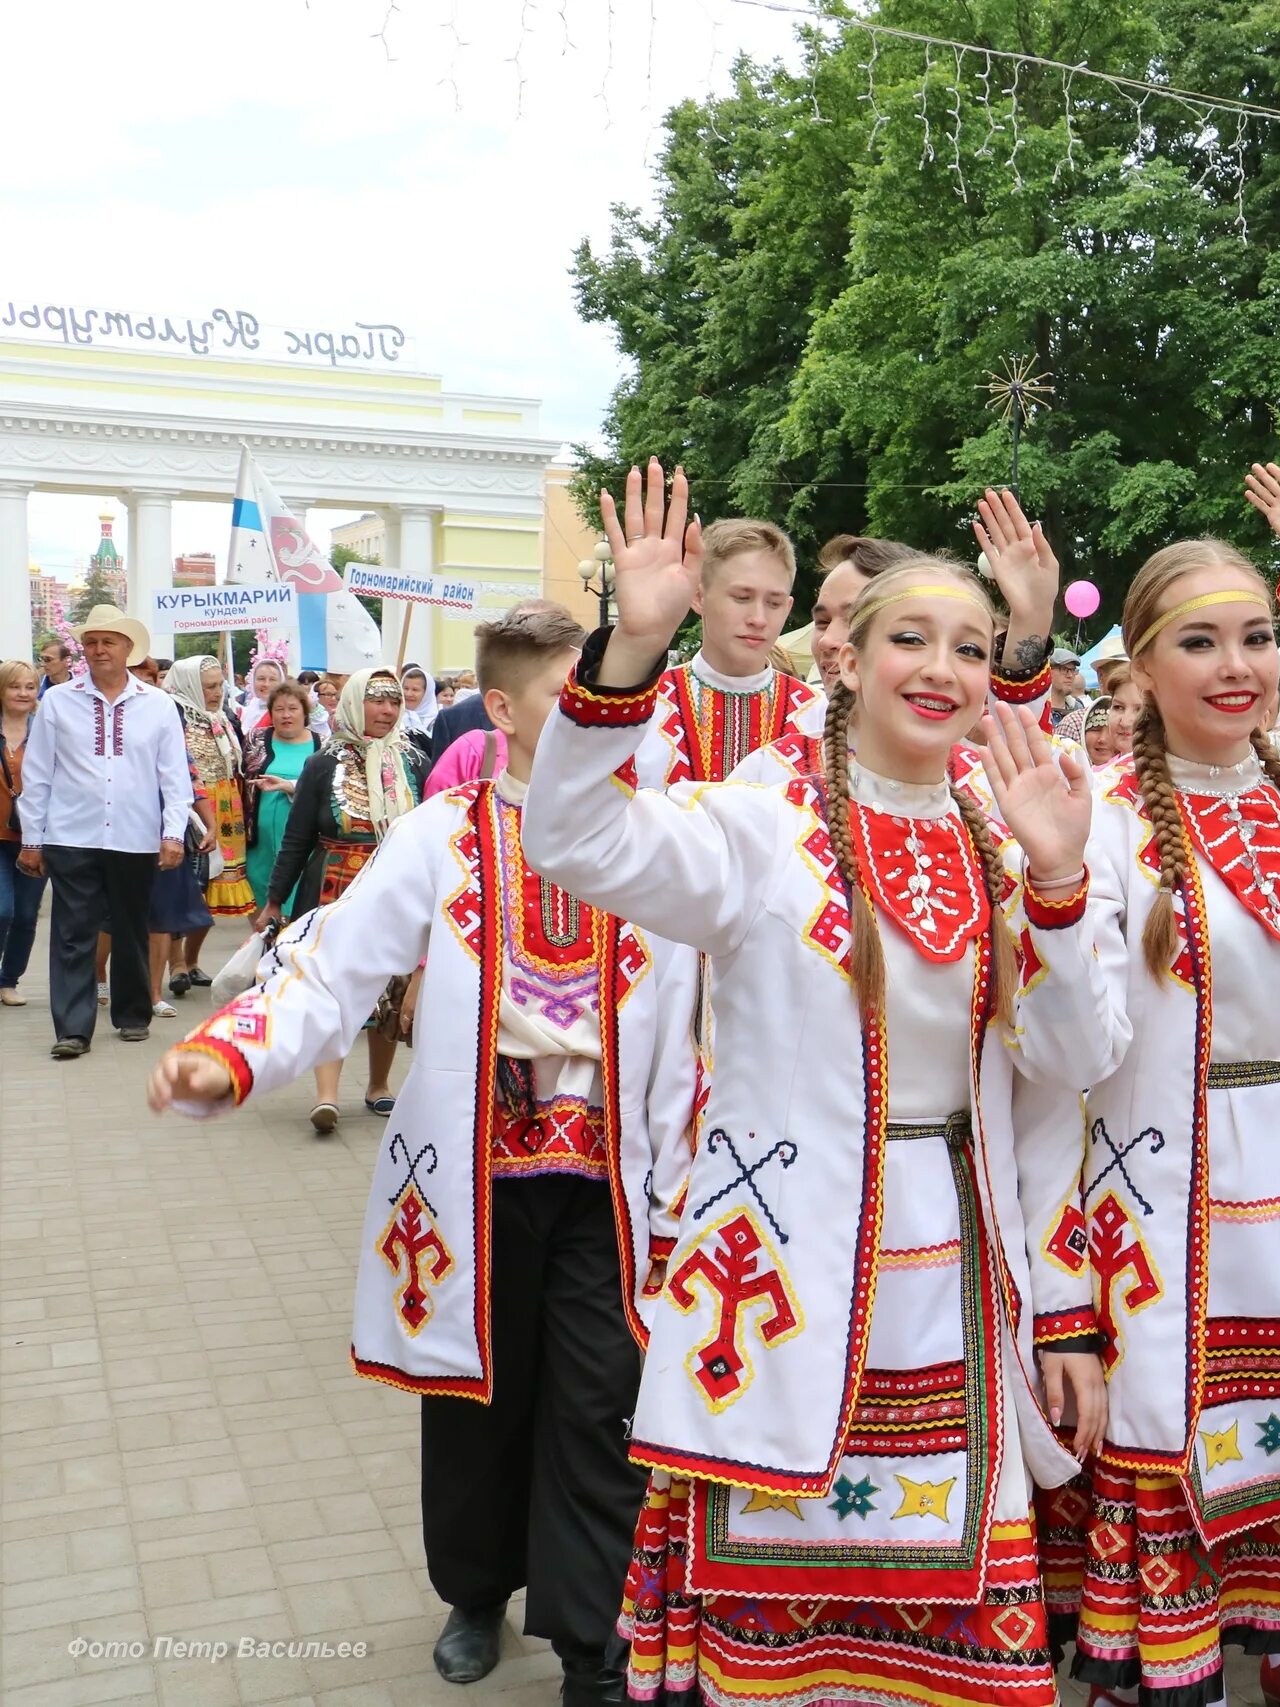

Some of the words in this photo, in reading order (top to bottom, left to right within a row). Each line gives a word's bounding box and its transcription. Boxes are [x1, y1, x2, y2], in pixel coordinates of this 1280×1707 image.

[349, 568, 434, 596] Горномарийский
[442, 583, 475, 601] район
[156, 585, 292, 610] КУРЫКМАРИЙ
[173, 617, 249, 630] Горномарийский
[251, 615, 278, 627] район
[204, 606, 247, 619] кундем
